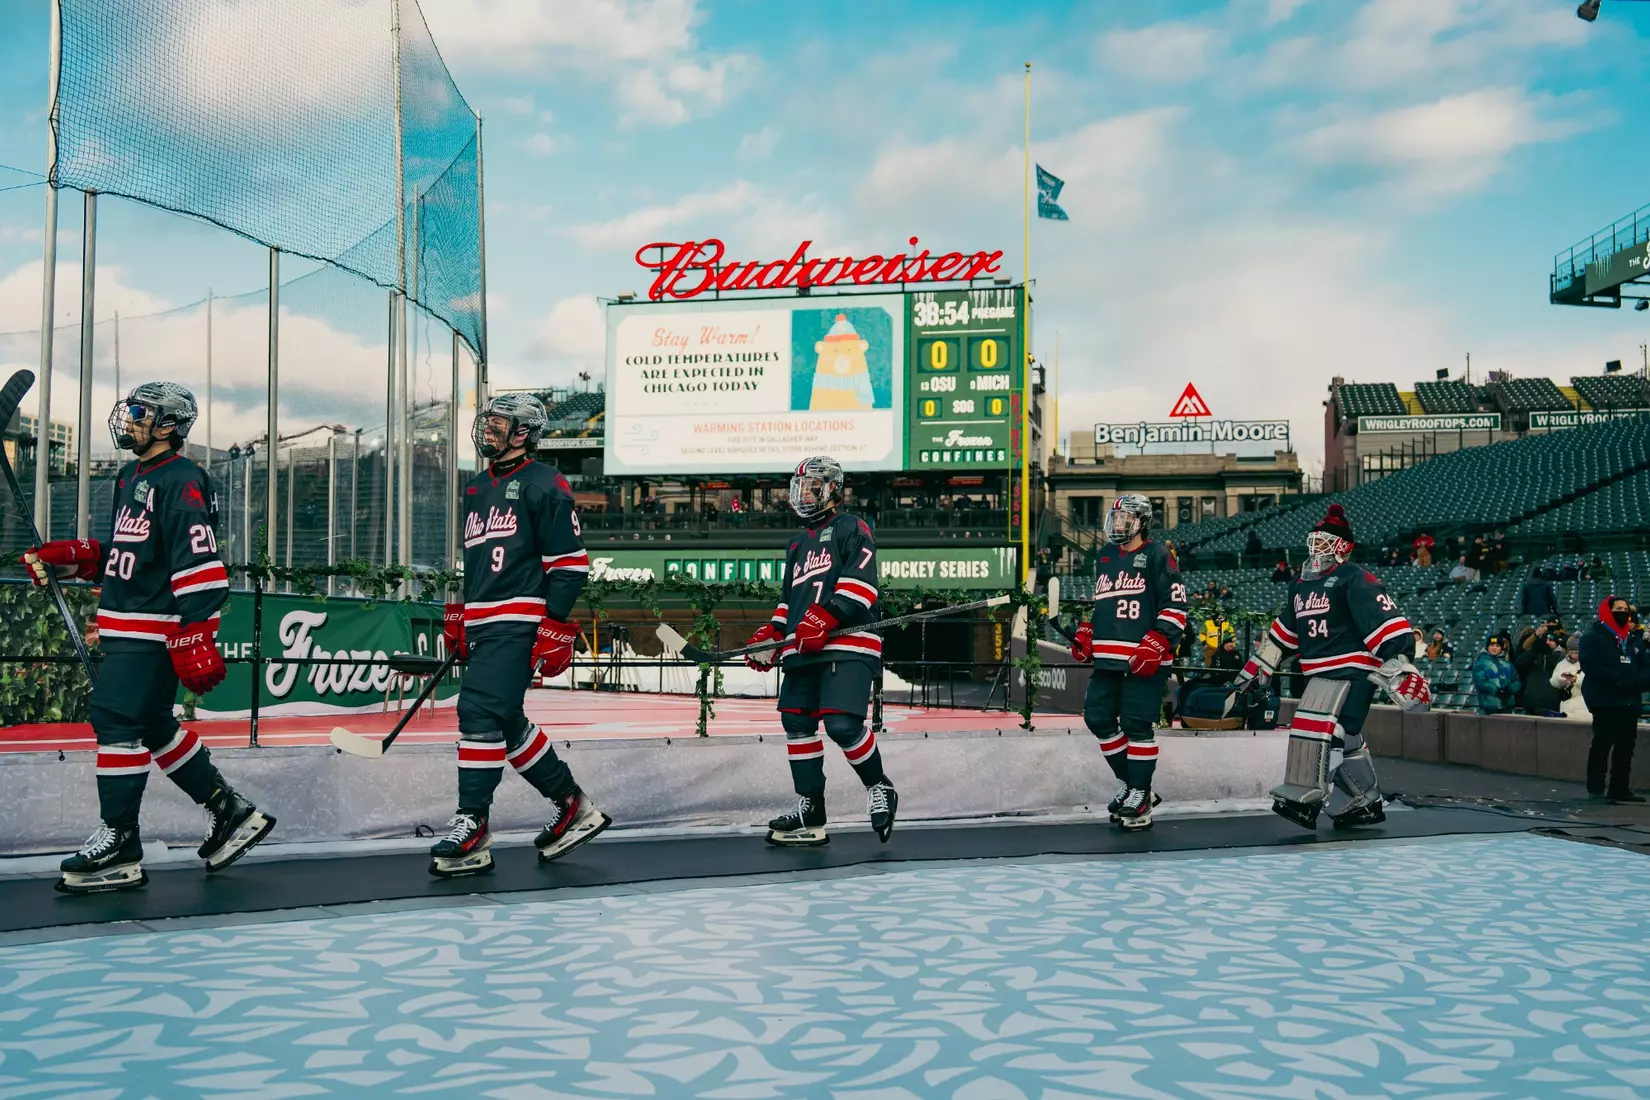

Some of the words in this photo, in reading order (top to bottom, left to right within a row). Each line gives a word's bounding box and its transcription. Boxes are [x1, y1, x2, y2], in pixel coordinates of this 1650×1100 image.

[635, 236, 1003, 300] Budweiser
[1629, 257, 1640, 267] THE
[914, 301, 970, 326] 38:54
[971, 306, 1016, 319] PREGAME
[652, 327, 690, 351] Stay
[700, 324, 761, 345] Warm!
[626, 355, 663, 366] COLD
[668, 351, 779, 365] TEMPERATURES
[931, 341, 947, 369] 0
[981, 339, 997, 368] 0
[641, 369, 669, 379] ARE
[674, 367, 744, 378] EXPECTED
[749, 366, 764, 376] IN
[976, 374, 1010, 391] MICH
[644, 382, 707, 393] CHICAGO
[713, 381, 760, 391] TODAY
[930, 376, 956, 392] OSU
[925, 400, 935, 416] 0
[952, 399, 974, 414] SOG
[991, 398, 1002, 415] 0
[693, 423, 744, 434] WARMING
[748, 421, 792, 432] STATION
[795, 420, 855, 431] LOCATIONS
[1365, 416, 1494, 430] WRIGLEYROOFTOPS.COM
[1095, 421, 1204, 448] Benjamin
[1210, 420, 1289, 442] Moore
[921, 451, 1005, 462] CONFINES
[146, 488, 154, 512] A
[1012, 486, 1021, 526] 353
[464, 511, 485, 540] Ohio
[485, 505, 518, 540] State
[571, 510, 581, 536] 9
[189, 524, 217, 554] 20
[105, 548, 136, 580] 20
[491, 546, 505, 572] 9
[803, 547, 832, 575] State
[858, 547, 873, 569] 7
[881, 560, 935, 578] HOCKEY
[940, 560, 989, 578] SERIES
[813, 581, 823, 604] 7
[1095, 574, 1113, 594] Ohio
[1115, 571, 1146, 595] State
[1171, 583, 1187, 602] 28
[1116, 599, 1140, 619] 28
[1305, 591, 1331, 612] State
[1376, 593, 1398, 611] 34
[1308, 619, 1329, 637] 34
